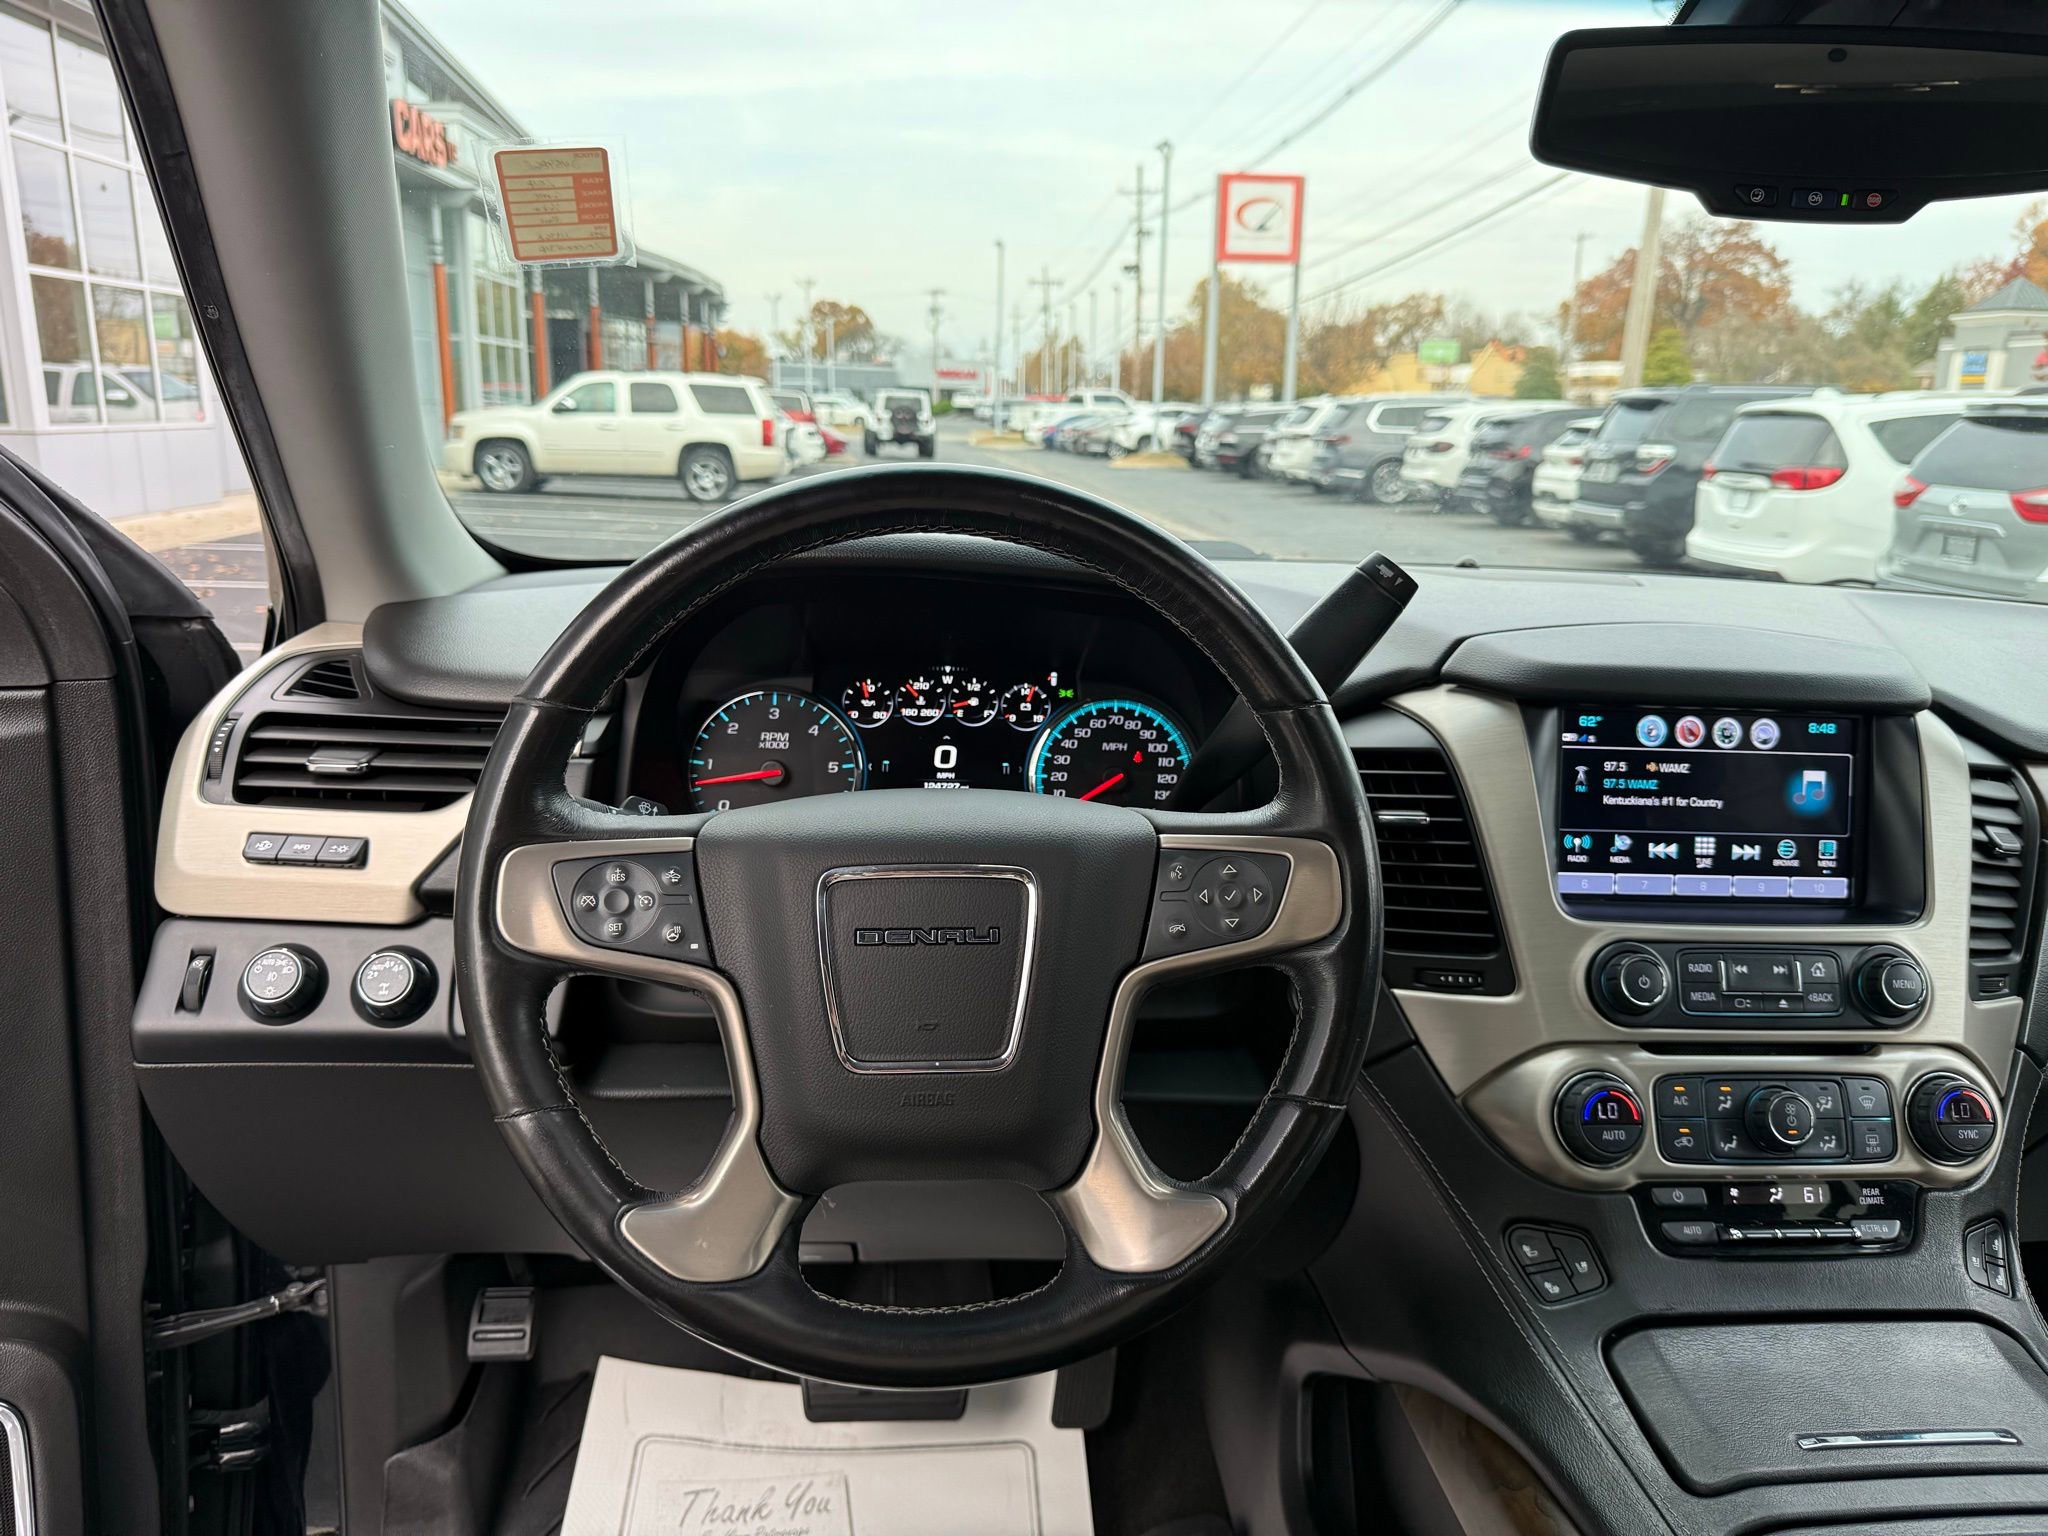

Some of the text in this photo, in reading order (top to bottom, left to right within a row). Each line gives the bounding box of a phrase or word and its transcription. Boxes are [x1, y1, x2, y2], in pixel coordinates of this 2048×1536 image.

[942, 675, 953, 684] W
[912, 682, 930, 691] 210
[769, 708, 780, 719] 3
[873, 711, 887, 720] 80
[1089, 719, 1106, 729] 60
[1108, 715, 1124, 725] 70
[1124, 720, 1142, 730] 80
[1578, 715, 1603, 727] 62°
[727, 723, 739, 735] 2
[808, 725, 819, 736] 4
[1074, 728, 1091, 738] 50
[1808, 722, 1837, 734] 8:48
[760, 732, 789, 741] RPM
[1139, 730, 1157, 740] 90
[1060, 739, 1078, 749] 40
[1102, 743, 1127, 751] MPH
[1147, 743, 1168, 753] 100
[933, 745, 957, 769] 0
[1053, 755, 1070, 765] 30
[1157, 757, 1175, 767] 110
[707, 759, 713, 770] 1
[828, 761, 839, 773] 5
[1603, 761, 1628, 772] 97.5
[1659, 763, 1691, 774] WAMZ
[1050, 772, 1068, 782] 20
[1157, 774, 1177, 784] 120
[1603, 779, 1659, 790] 97.5 WAMZ
[1053, 789, 1066, 798] 10
[718, 800, 730, 810] 0
[1602, 795, 1724, 809] Kentuckiana's #1 for Country
[1567, 855, 1588, 863] RADIO
[1609, 856, 1631, 864] MEDIA
[1817, 860, 1837, 868] MENU
[611, 873, 626, 882] RES
[1581, 880, 1588, 889] 6
[1641, 880, 1648, 889] 7
[1758, 882, 1765, 892] 9
[1813, 883, 1825, 893] 10
[608, 924, 622, 932] SET
[855, 927, 1000, 945] DENALI
[1688, 963, 1713, 974] RADIO
[1893, 979, 1916, 990] MENU
[1690, 991, 1716, 1002] MEDIA
[1812, 992, 1834, 1003] BACK
[900, 1091, 954, 1107] AIRBAG
[1673, 1096, 1689, 1106] A/C
[1597, 1102, 1618, 1120] LO
[1952, 1102, 1970, 1118] LO
[1602, 1130, 1626, 1141] AUTO
[1958, 1129, 1979, 1140] SYNC
[1804, 1187, 1823, 1203] 61
[1862, 1188, 1880, 1196] REAR
[1859, 1196, 1885, 1205] CLIMATE
[1683, 1226, 1701, 1235] AUTO
[679, 1479, 832, 1527] Thank You
